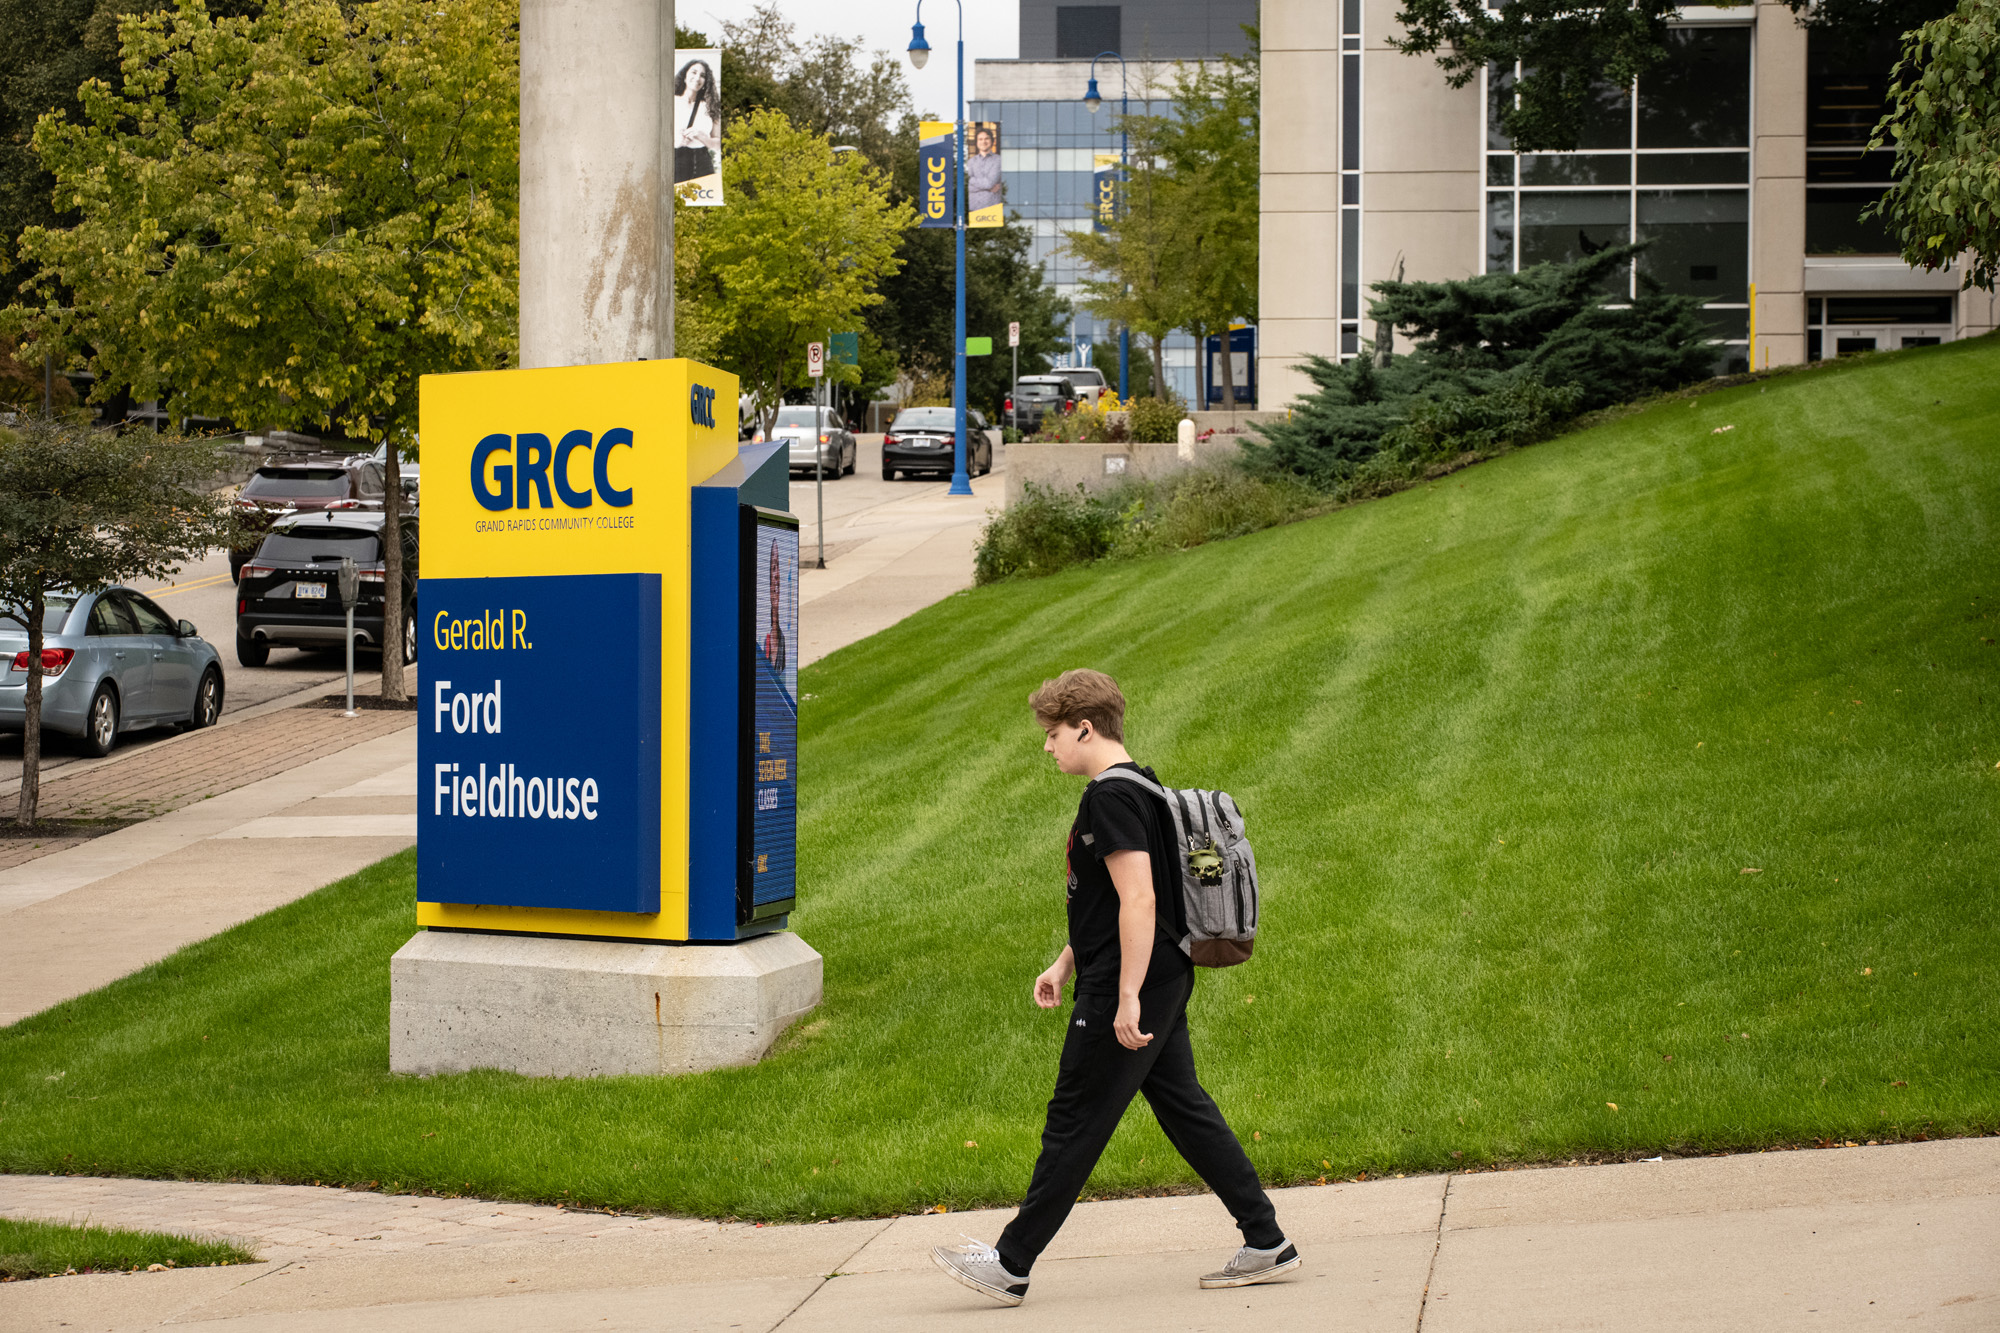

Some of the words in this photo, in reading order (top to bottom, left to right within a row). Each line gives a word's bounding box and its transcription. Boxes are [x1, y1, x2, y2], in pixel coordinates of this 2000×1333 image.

[927, 157, 946, 219] GRCC
[975, 214, 997, 222] GRCC
[690, 382, 716, 430] GRCC
[470, 427, 634, 512] GRCC
[475, 520, 505, 533] GRAND
[507, 518, 537, 531] RAPIDS
[538, 517, 594, 531] COMMUNITY
[596, 516, 635, 529] COLLEGE
[433, 609, 505, 651] Gerald
[512, 609, 533, 650] R.
[434, 679, 502, 735] Ford
[434, 762, 599, 821] Fieldhouse
[758, 788, 778, 810] CLASSES
